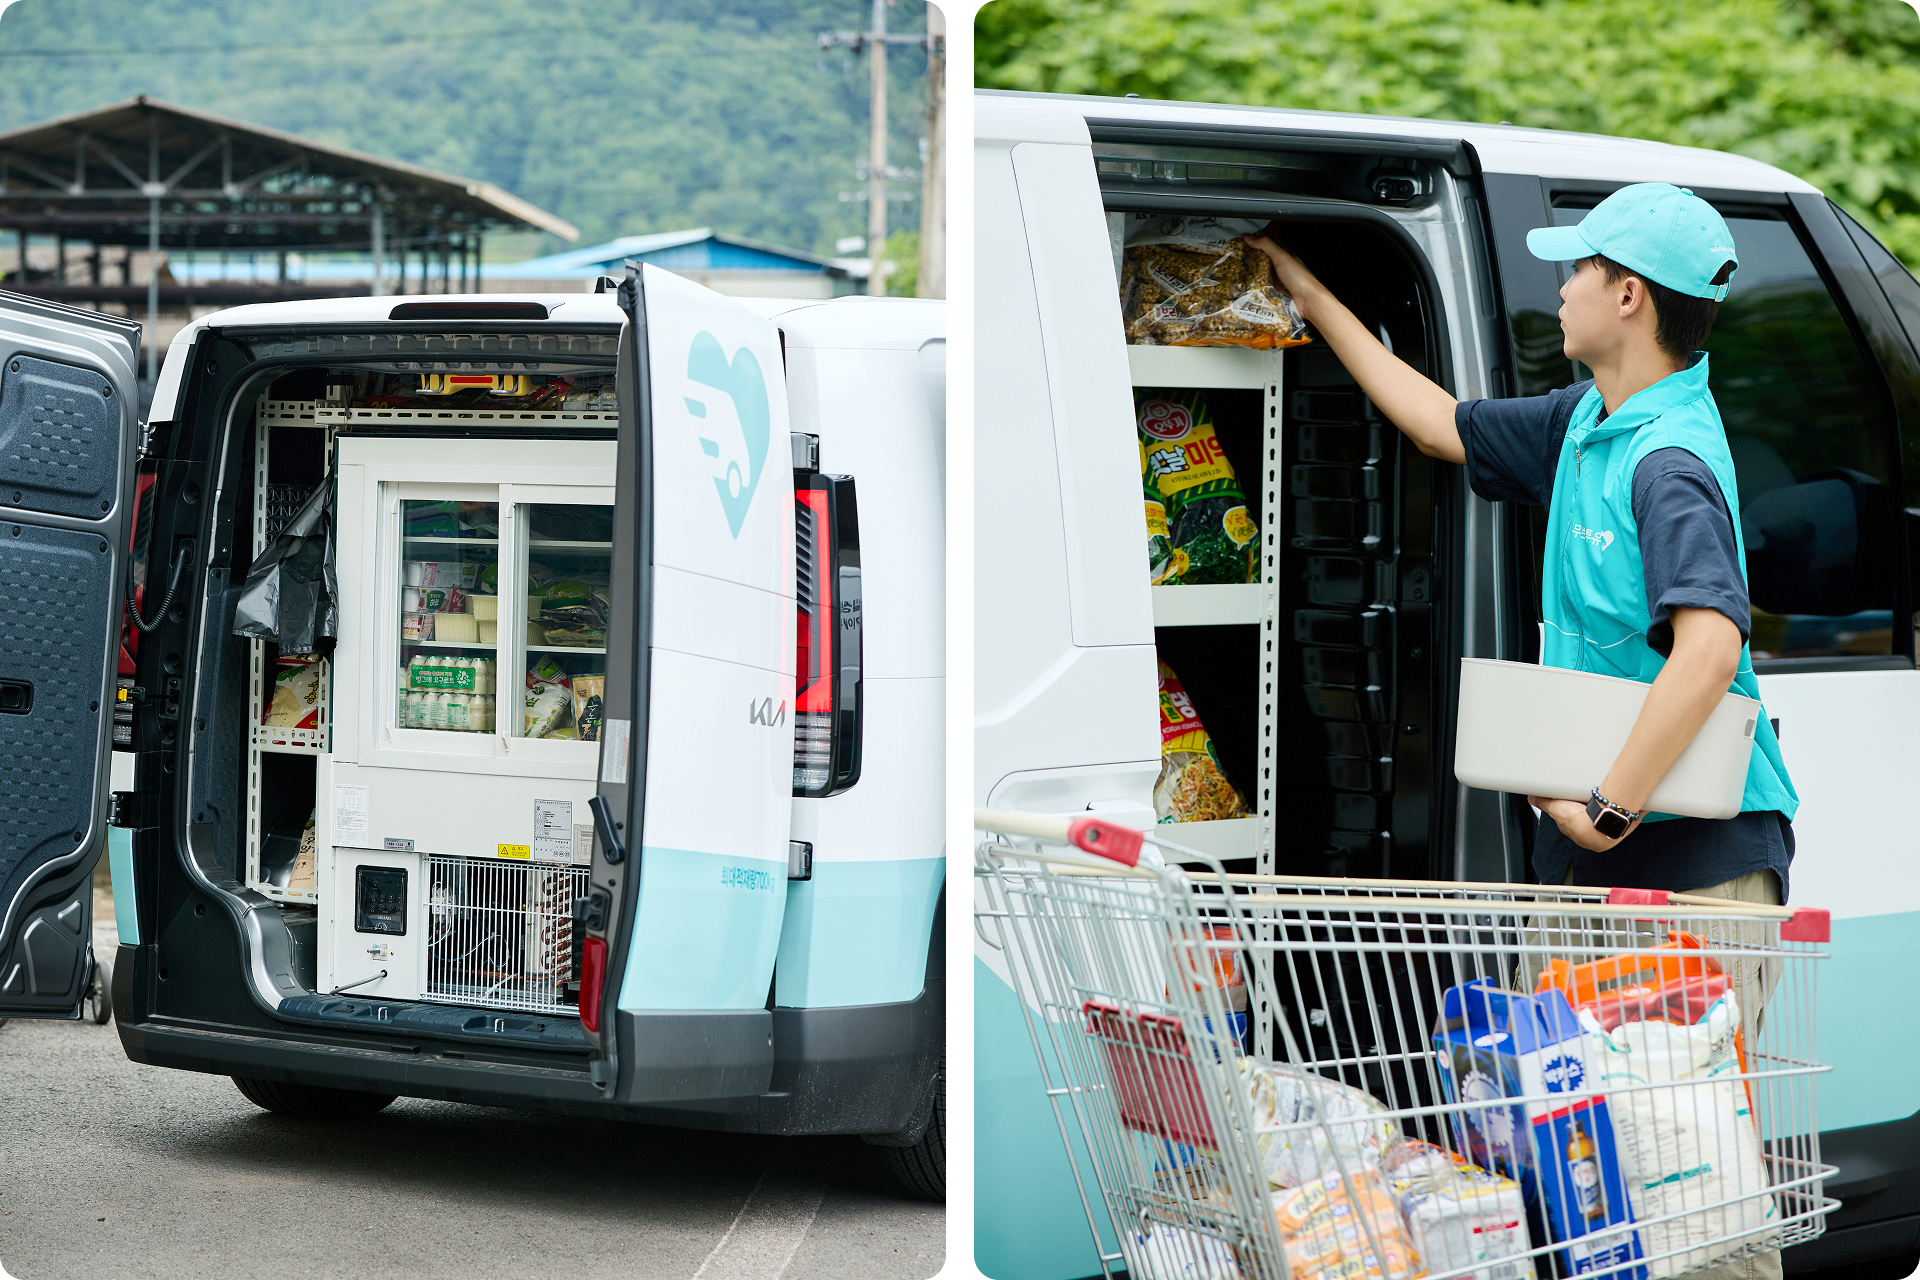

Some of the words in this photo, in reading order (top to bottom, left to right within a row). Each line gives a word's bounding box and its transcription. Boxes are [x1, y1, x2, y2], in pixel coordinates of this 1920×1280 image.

[1154, 416, 1185, 433] 오뚜기
[415, 676, 433, 684] 빙그레
[749, 695, 786, 728] KIA
[721, 866, 776, 893] 최대적재량700kg
